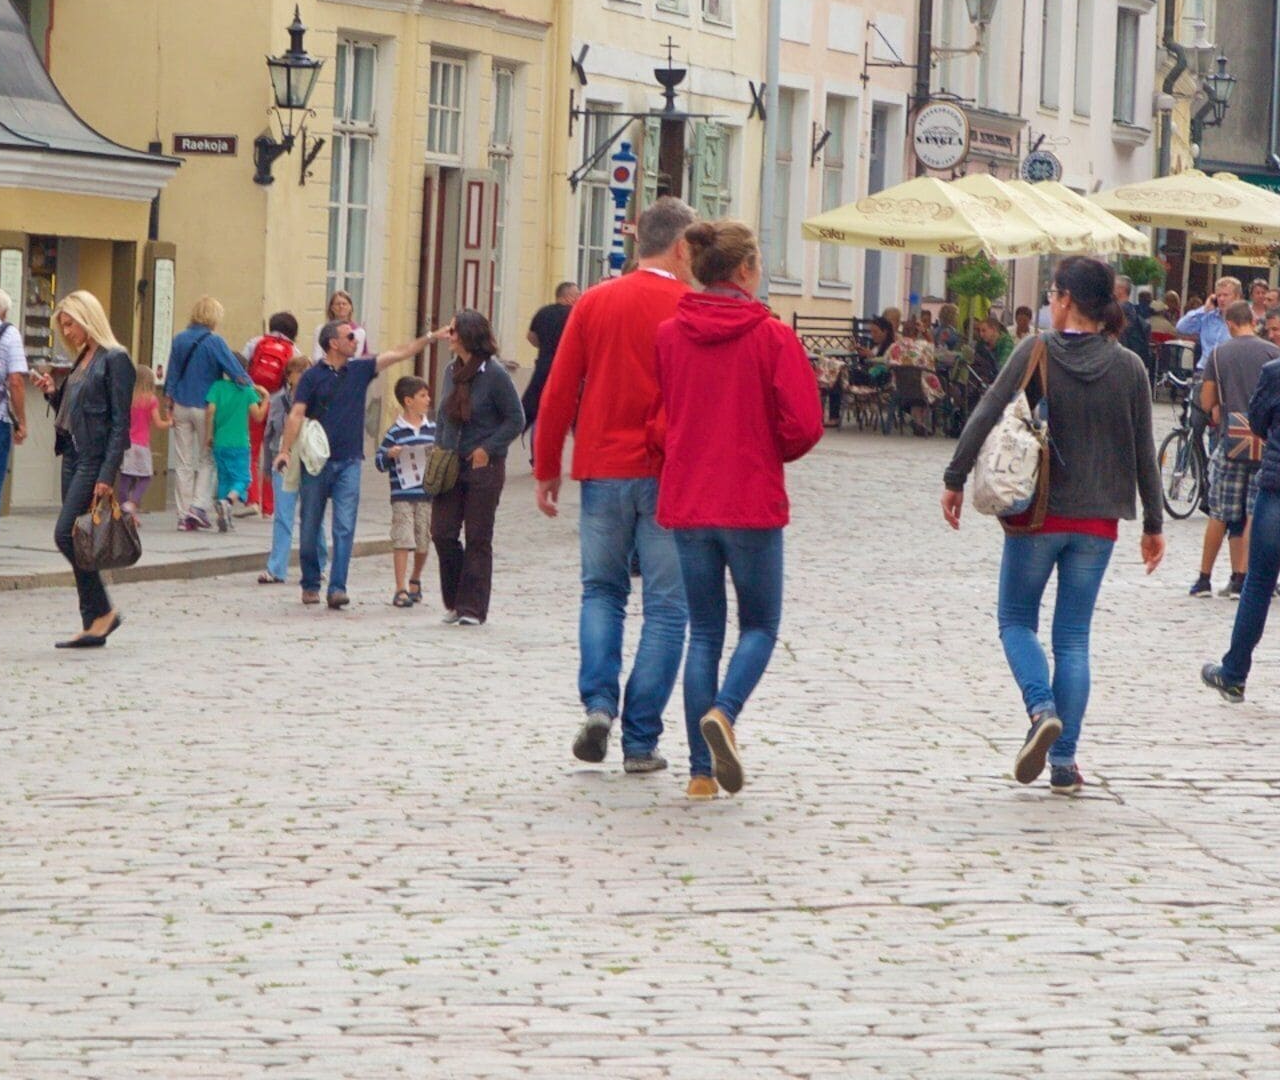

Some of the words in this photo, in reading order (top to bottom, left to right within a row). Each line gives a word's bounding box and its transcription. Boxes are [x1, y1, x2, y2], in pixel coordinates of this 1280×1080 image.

[182, 138, 228, 153] Raekoja
[819, 228, 846, 241] saku
[879, 234, 906, 248] saku
[938, 241, 964, 255] saku
